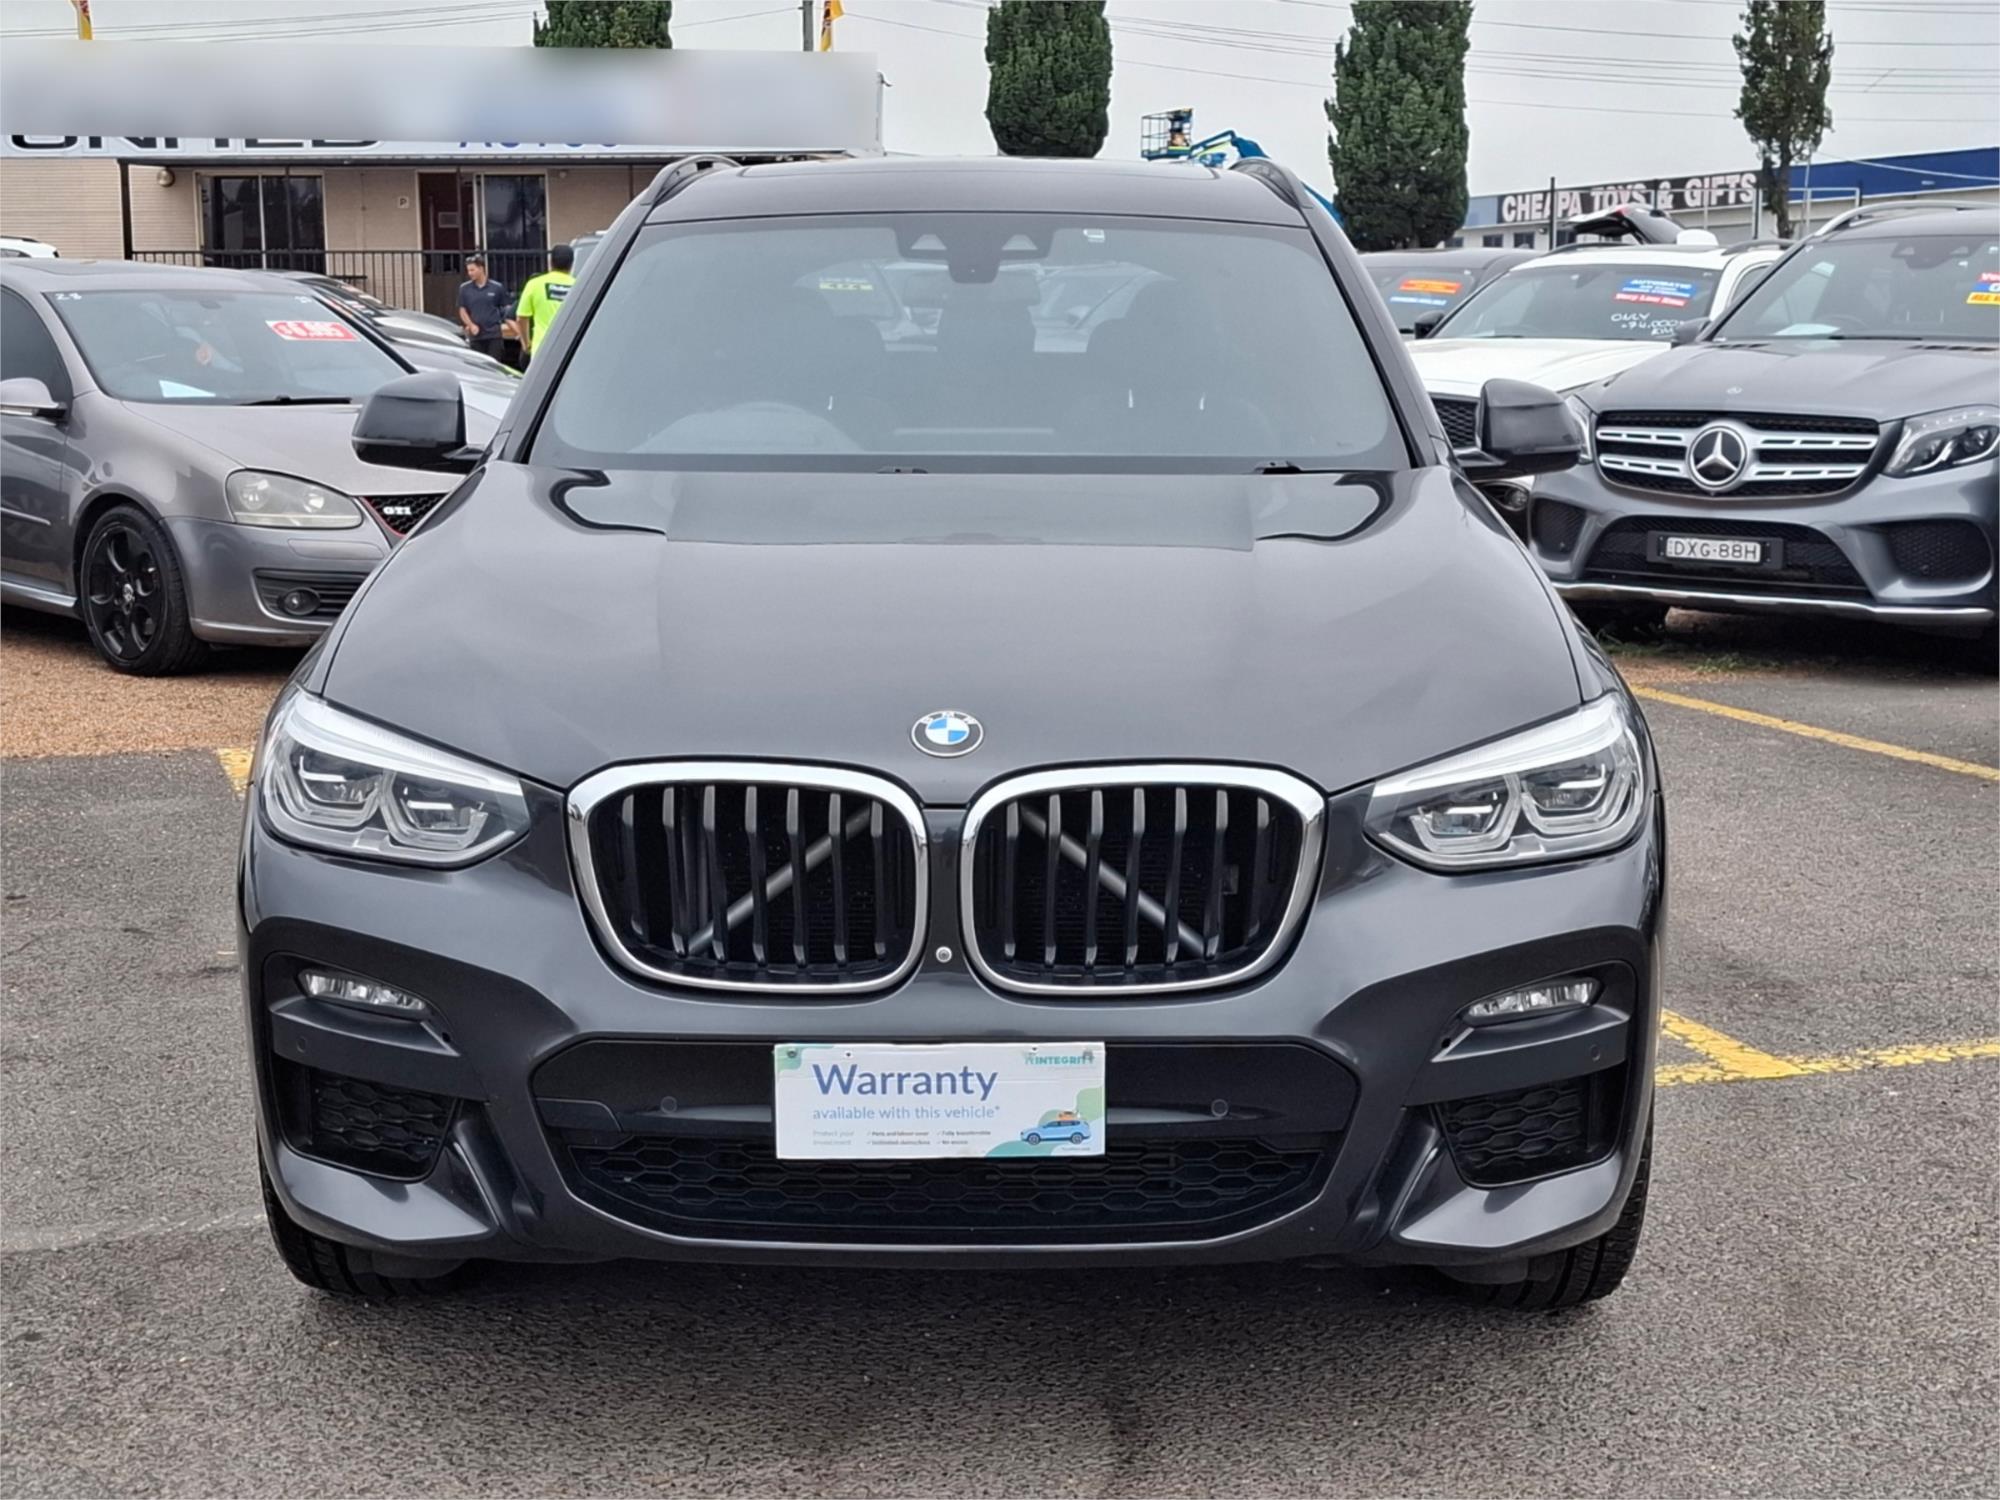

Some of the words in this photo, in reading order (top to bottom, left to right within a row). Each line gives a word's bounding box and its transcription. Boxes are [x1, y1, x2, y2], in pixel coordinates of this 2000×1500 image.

[1591, 182, 1648, 210] TOYS
[1658, 181, 1674, 210] &
[1684, 173, 1758, 208] GIFTS
[383, 505, 412, 516] GTI
[812, 1063, 999, 1101] Warranty
[813, 1106, 875, 1120] available
[878, 1106, 911, 1119] with
[914, 1106, 941, 1119] this
